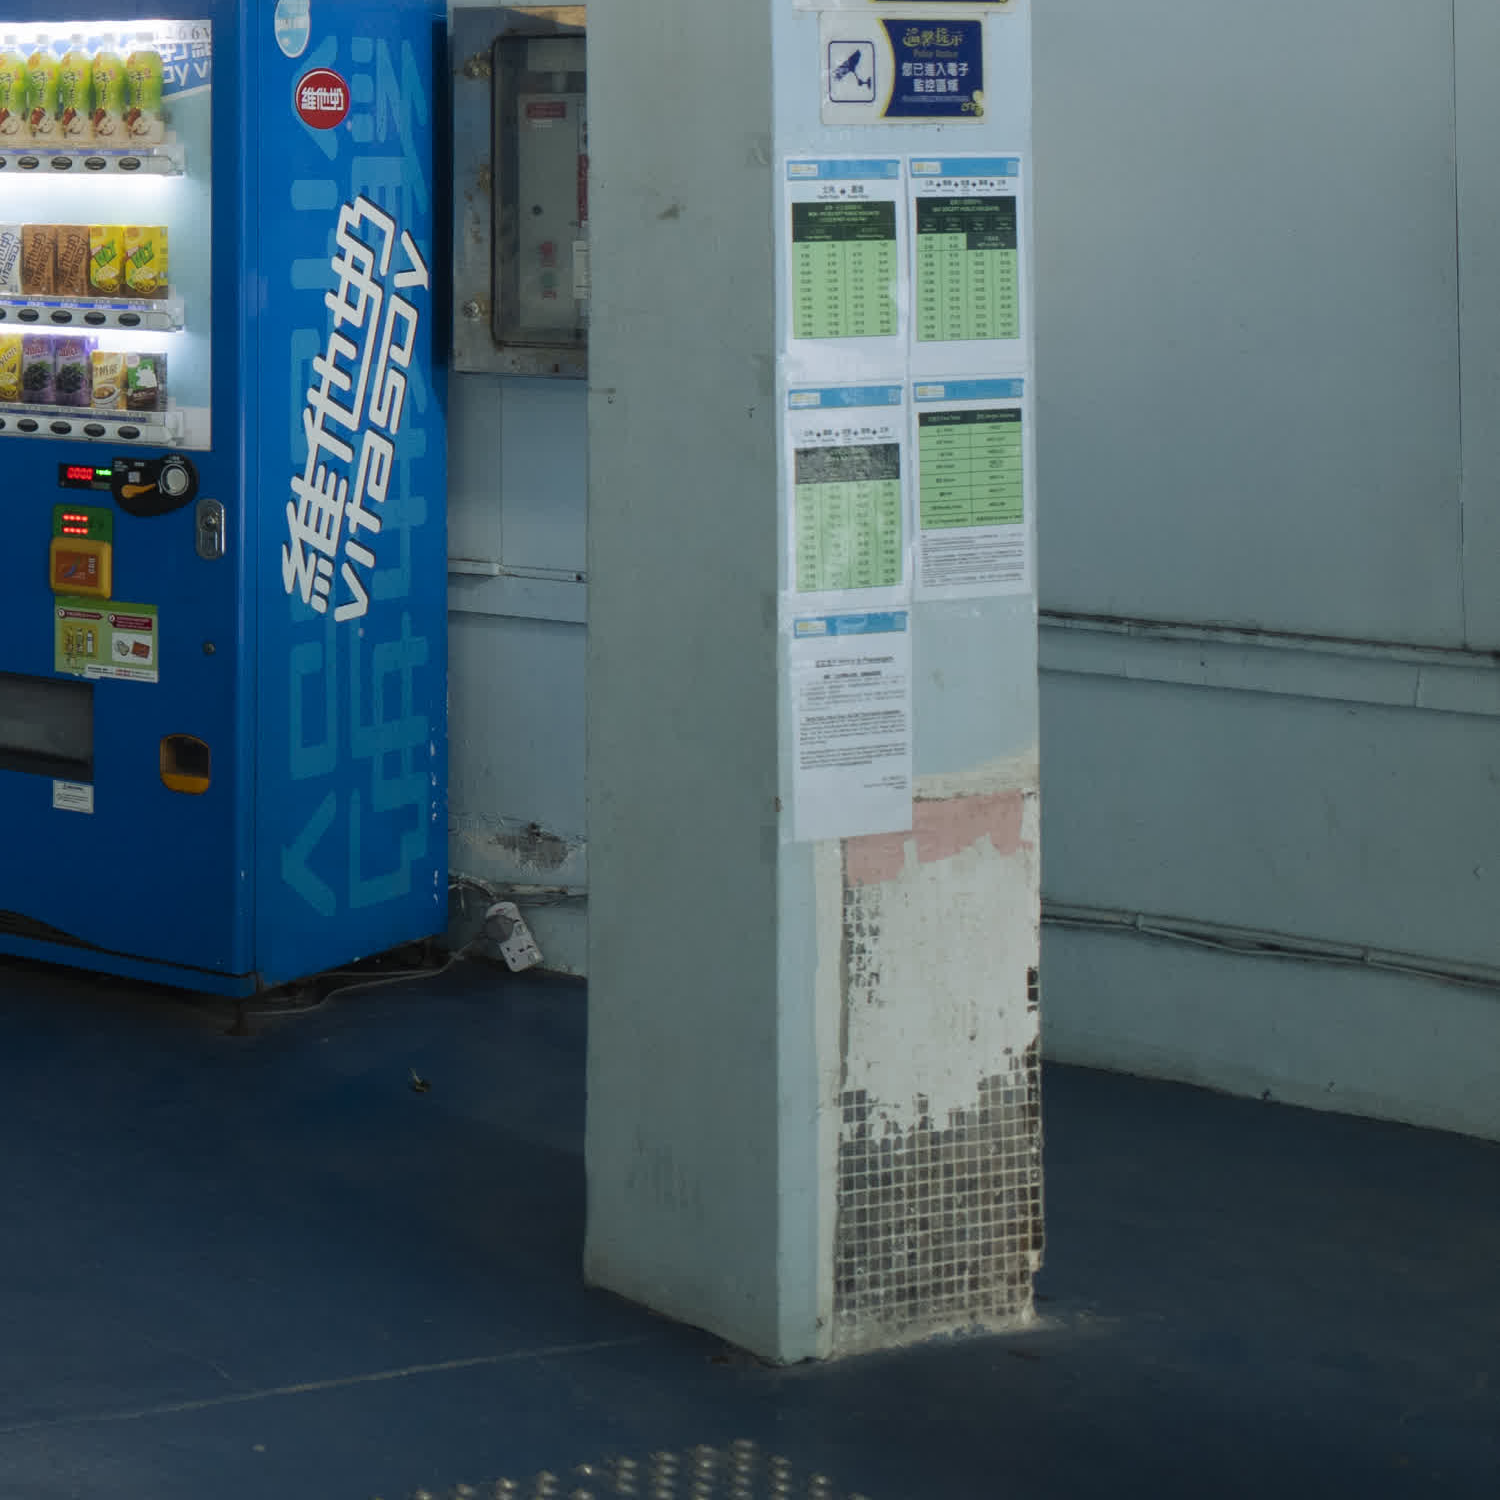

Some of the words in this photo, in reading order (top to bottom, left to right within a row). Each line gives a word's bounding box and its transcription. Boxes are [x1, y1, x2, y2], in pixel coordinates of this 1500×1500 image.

[301, 87, 344, 111] 維他奶
[282, 194, 395, 614] 維他奶
